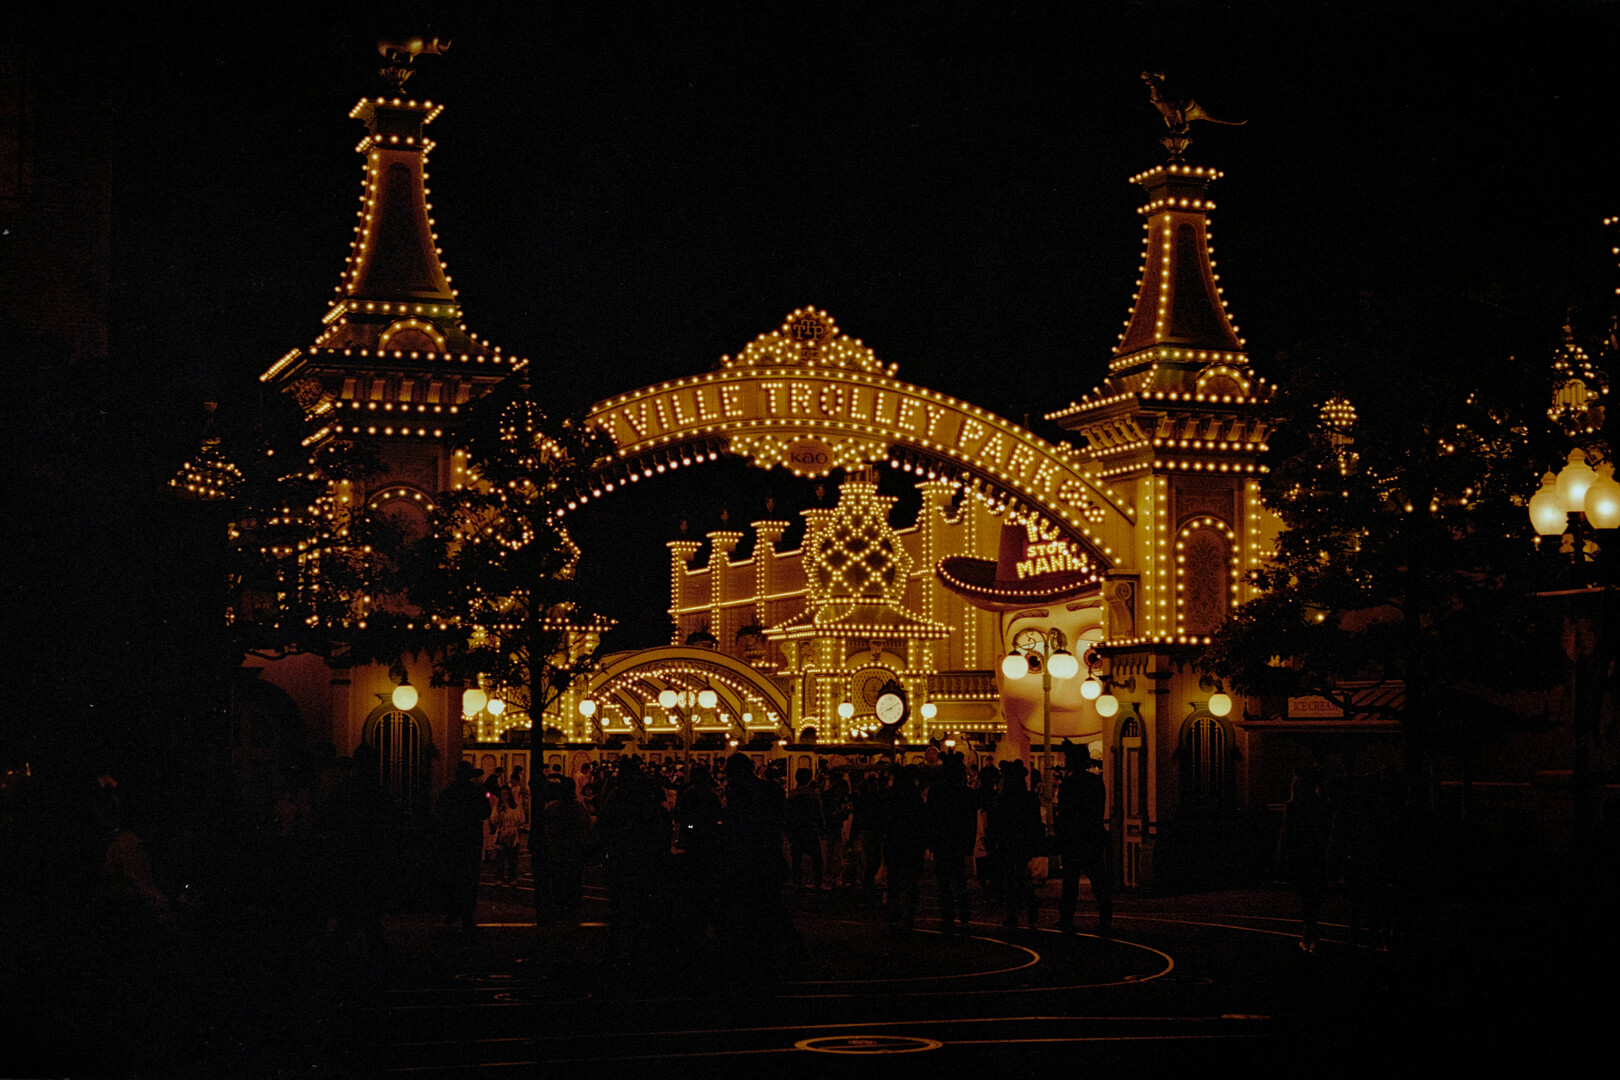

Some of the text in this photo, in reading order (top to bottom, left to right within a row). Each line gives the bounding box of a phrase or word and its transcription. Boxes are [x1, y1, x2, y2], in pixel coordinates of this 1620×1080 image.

[793, 319, 824, 340] TTP
[586, 382, 1060, 493] YVILLE TROLLEY PARK
